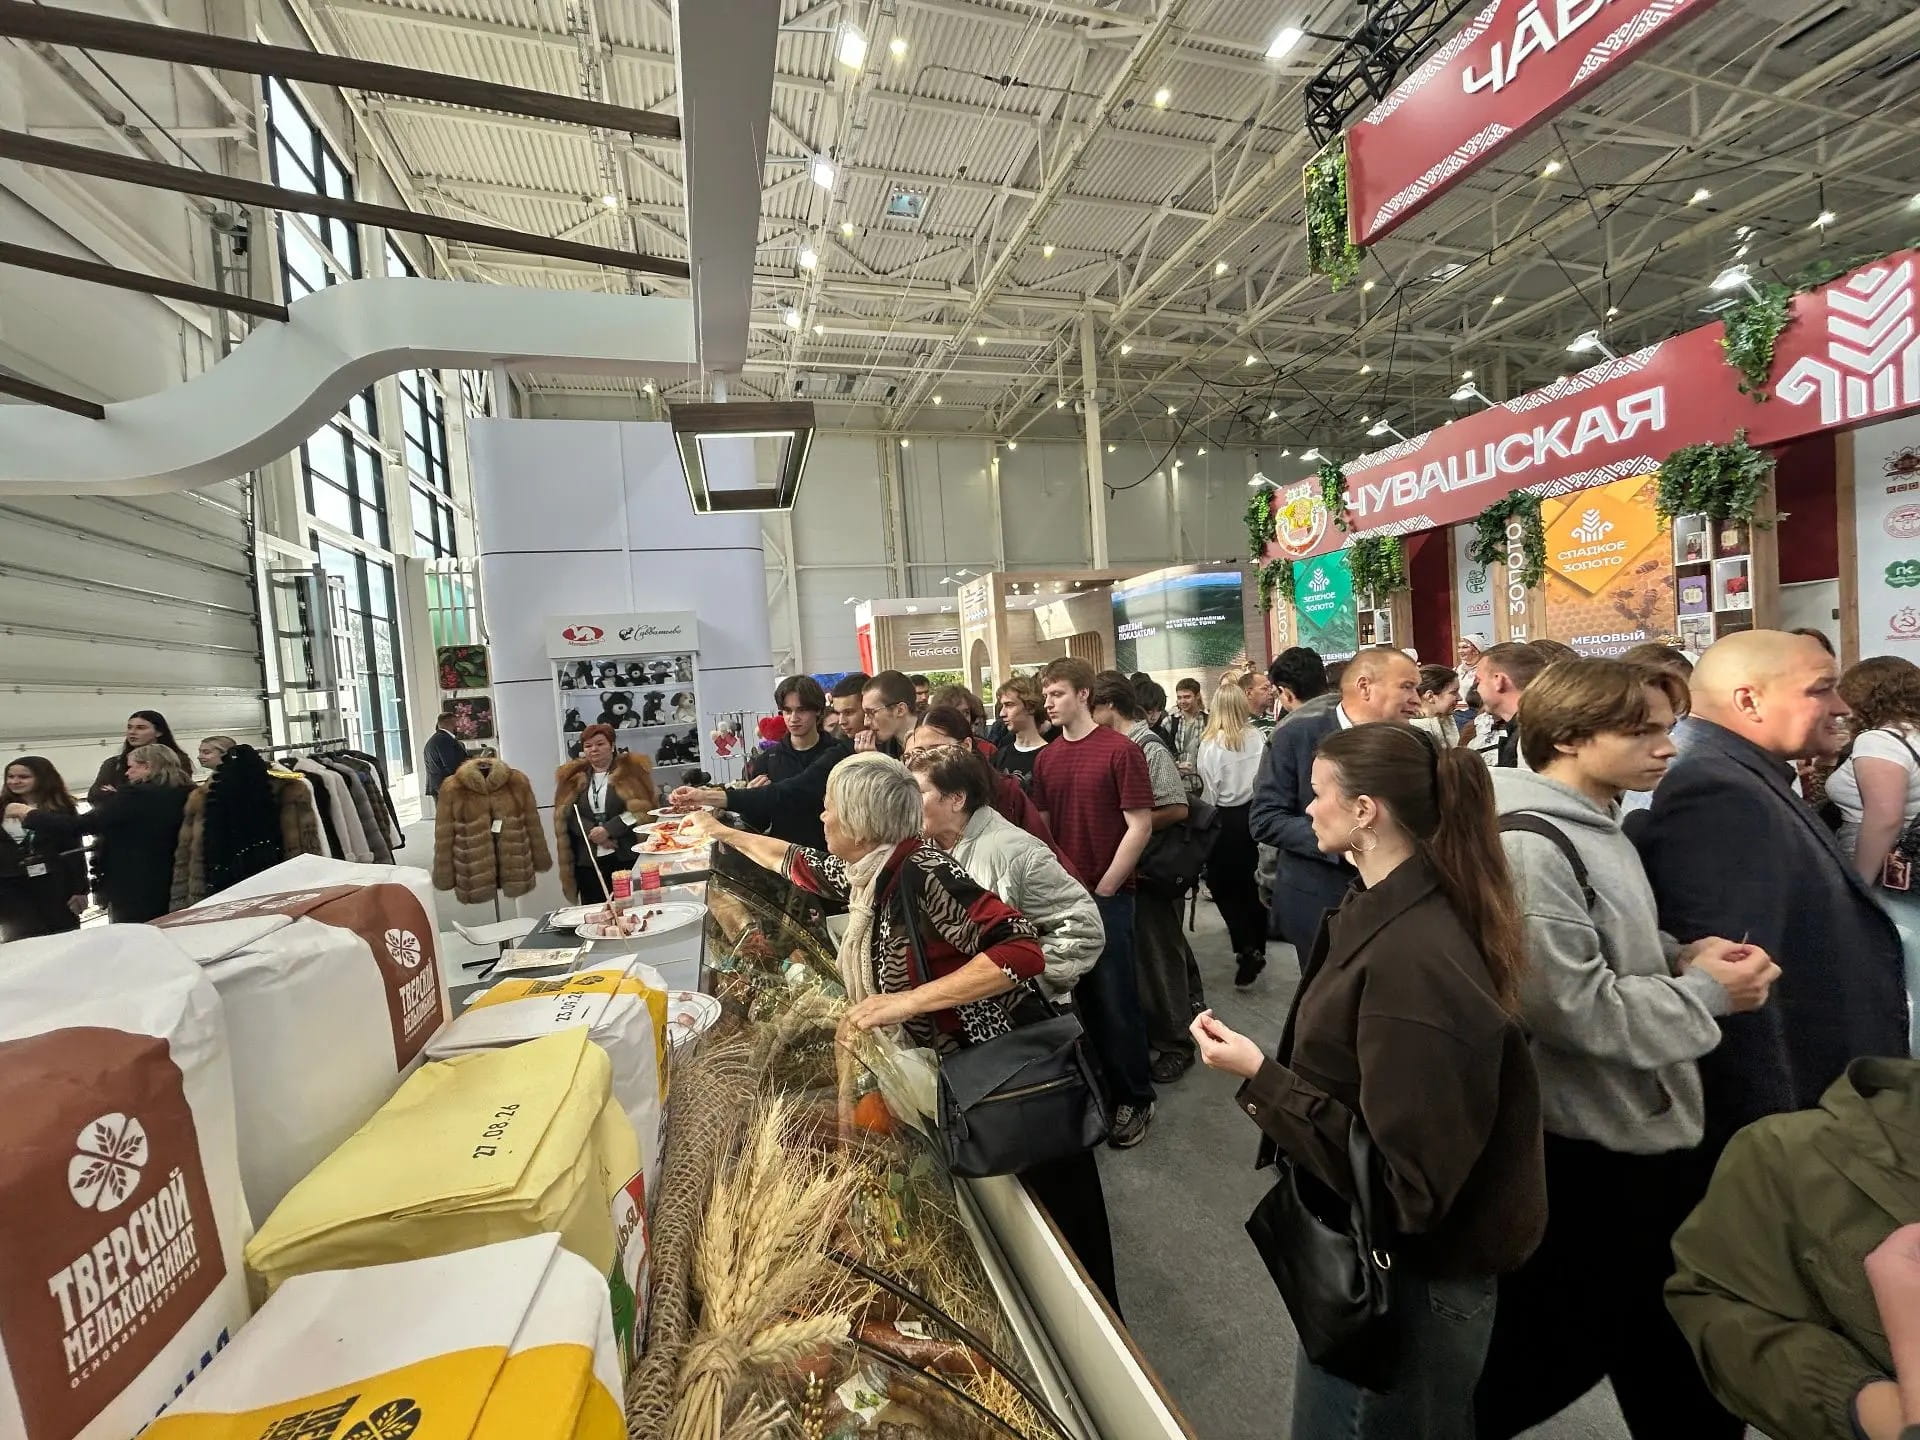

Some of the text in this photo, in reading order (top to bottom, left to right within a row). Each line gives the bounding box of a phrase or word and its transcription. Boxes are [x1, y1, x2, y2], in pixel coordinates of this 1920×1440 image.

[1344, 385, 1666, 517] ЧУВАШСКАЯ
[1506, 522, 1526, 616] ЗОЛОТО
[1557, 540, 1628, 561] СЛАДКОЕ
[1562, 556, 1623, 573] ЗОЛОТО
[1571, 629, 1646, 646] МЕДОВЫЙ
[1591, 645, 1631, 656] ЧУВА
[472, 1104, 520, 1159] 27.08.26
[48, 1166, 192, 1332] ТВЕРСКОЙ
[63, 1228, 197, 1374] МЕЛЬКОМБИНАТ
